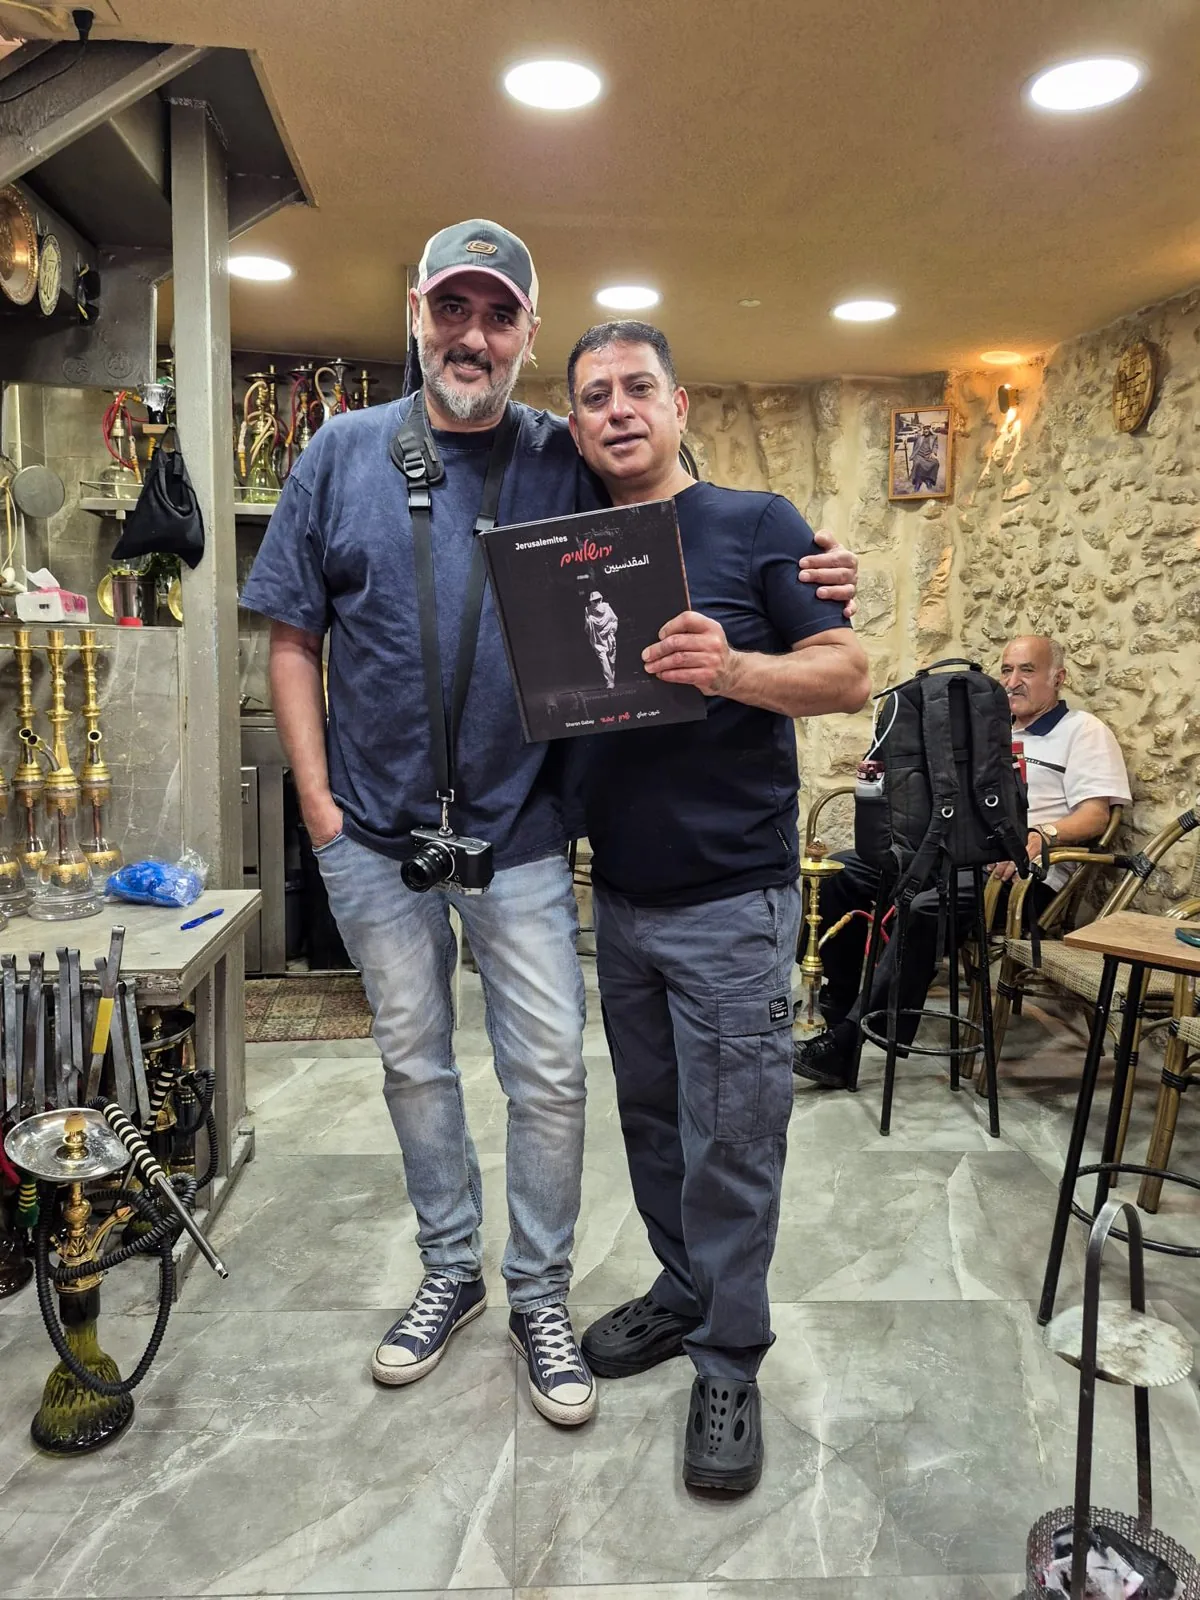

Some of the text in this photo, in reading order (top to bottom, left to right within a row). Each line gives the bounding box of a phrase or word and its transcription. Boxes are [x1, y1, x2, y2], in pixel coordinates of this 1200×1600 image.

[515, 535, 568, 550] Jerusalemites
[560, 538, 613, 568] ירושלמים
[604, 554, 650, 574] المقدسيين
